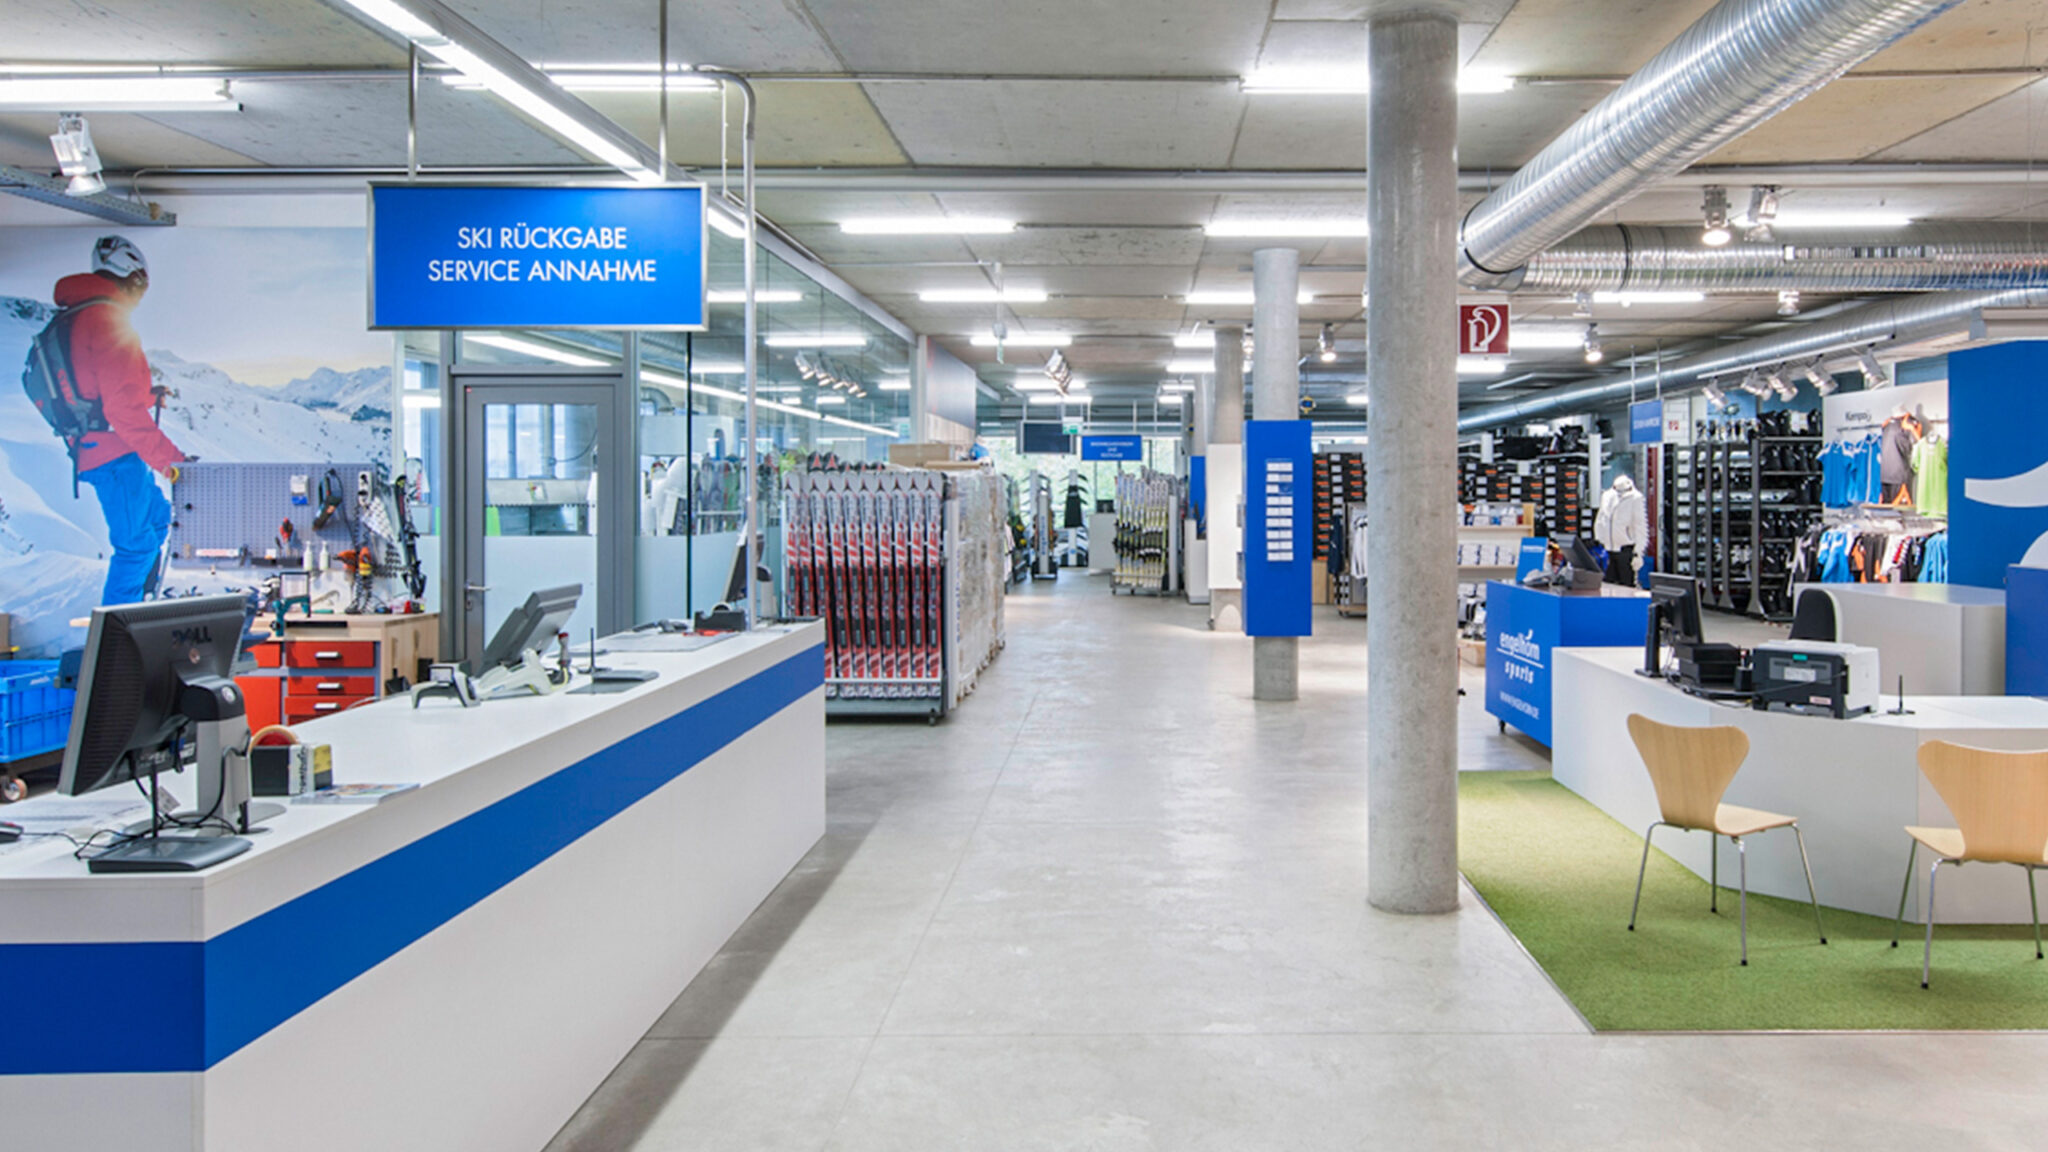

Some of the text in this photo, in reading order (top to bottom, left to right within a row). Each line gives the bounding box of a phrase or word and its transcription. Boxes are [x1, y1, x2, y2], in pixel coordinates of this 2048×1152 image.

[457, 222, 627, 249] SKI RÜCKGABE
[428, 259, 656, 282] SERVICE ANNAHME
[1504, 661, 1534, 684] sports
